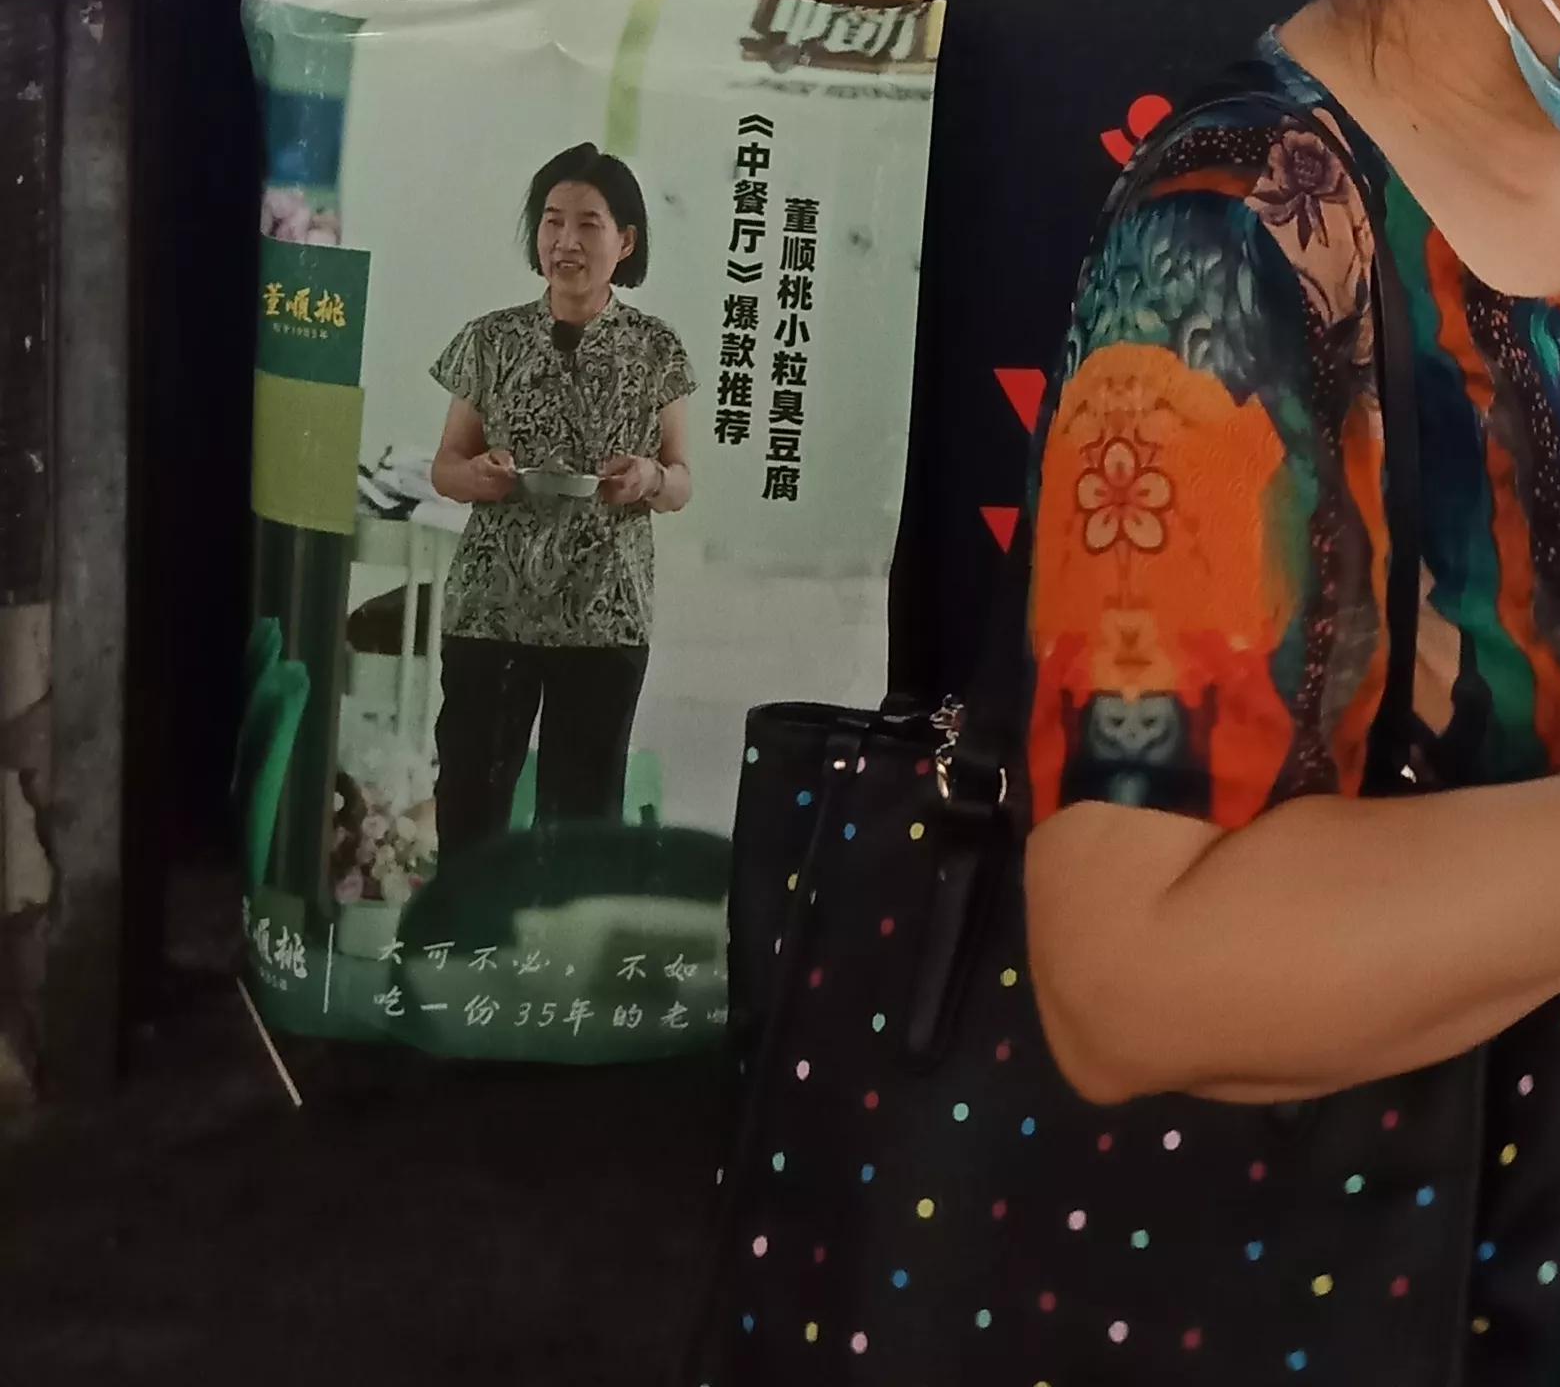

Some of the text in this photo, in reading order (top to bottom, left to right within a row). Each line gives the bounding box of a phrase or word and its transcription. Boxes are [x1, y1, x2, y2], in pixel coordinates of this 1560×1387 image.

[713, 113, 774, 446] 《中餐厅》爆款推荐
[761, 197, 820, 502] 董顺桃小粒臭豆腐
